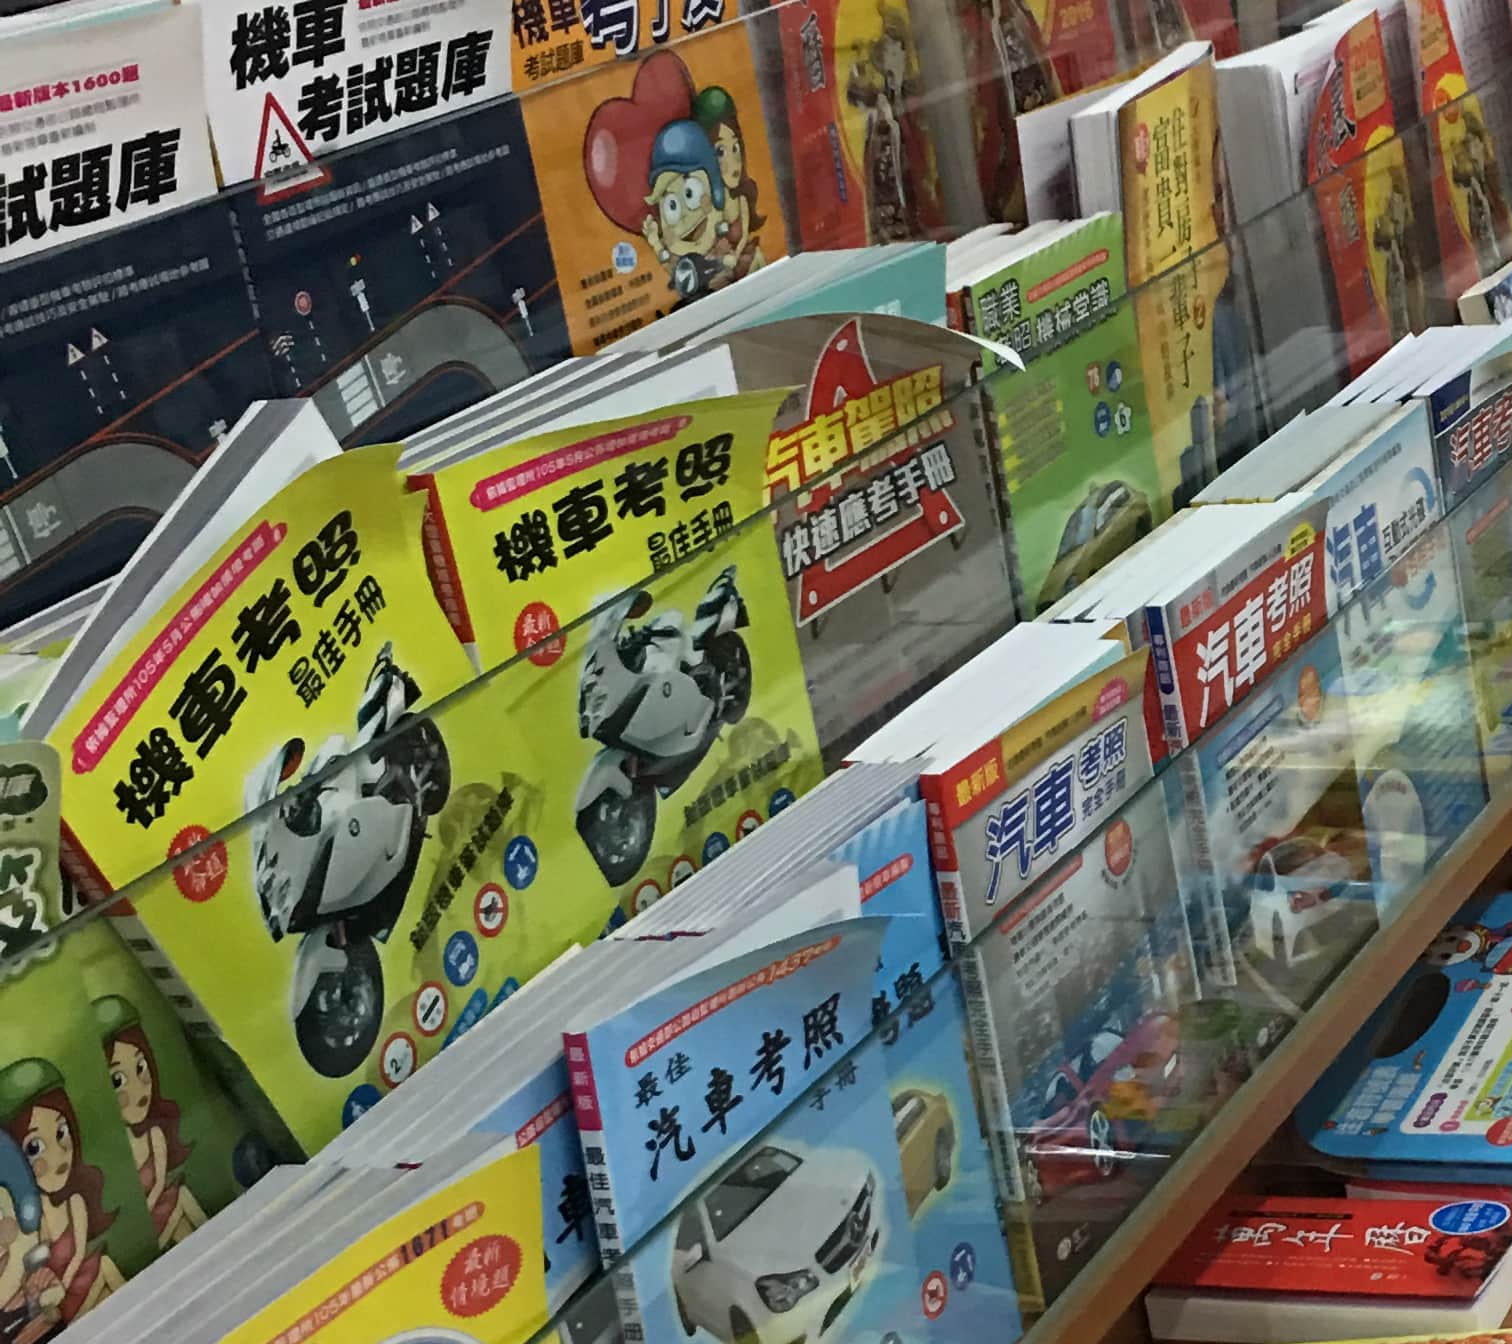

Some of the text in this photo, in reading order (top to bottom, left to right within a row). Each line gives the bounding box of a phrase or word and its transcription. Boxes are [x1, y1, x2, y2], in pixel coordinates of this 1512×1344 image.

[298, 30, 494, 142] 考試題庫
[493, 433, 734, 584] 機車考照
[782, 443, 955, 578] 快速應考手冊
[114, 510, 361, 830] 機車考照
[287, 575, 387, 709] 最佳手冊
[985, 716, 1128, 905] 汽車考照
[634, 1053, 692, 1108] 最佳
[646, 993, 843, 1182] 汽車考照
